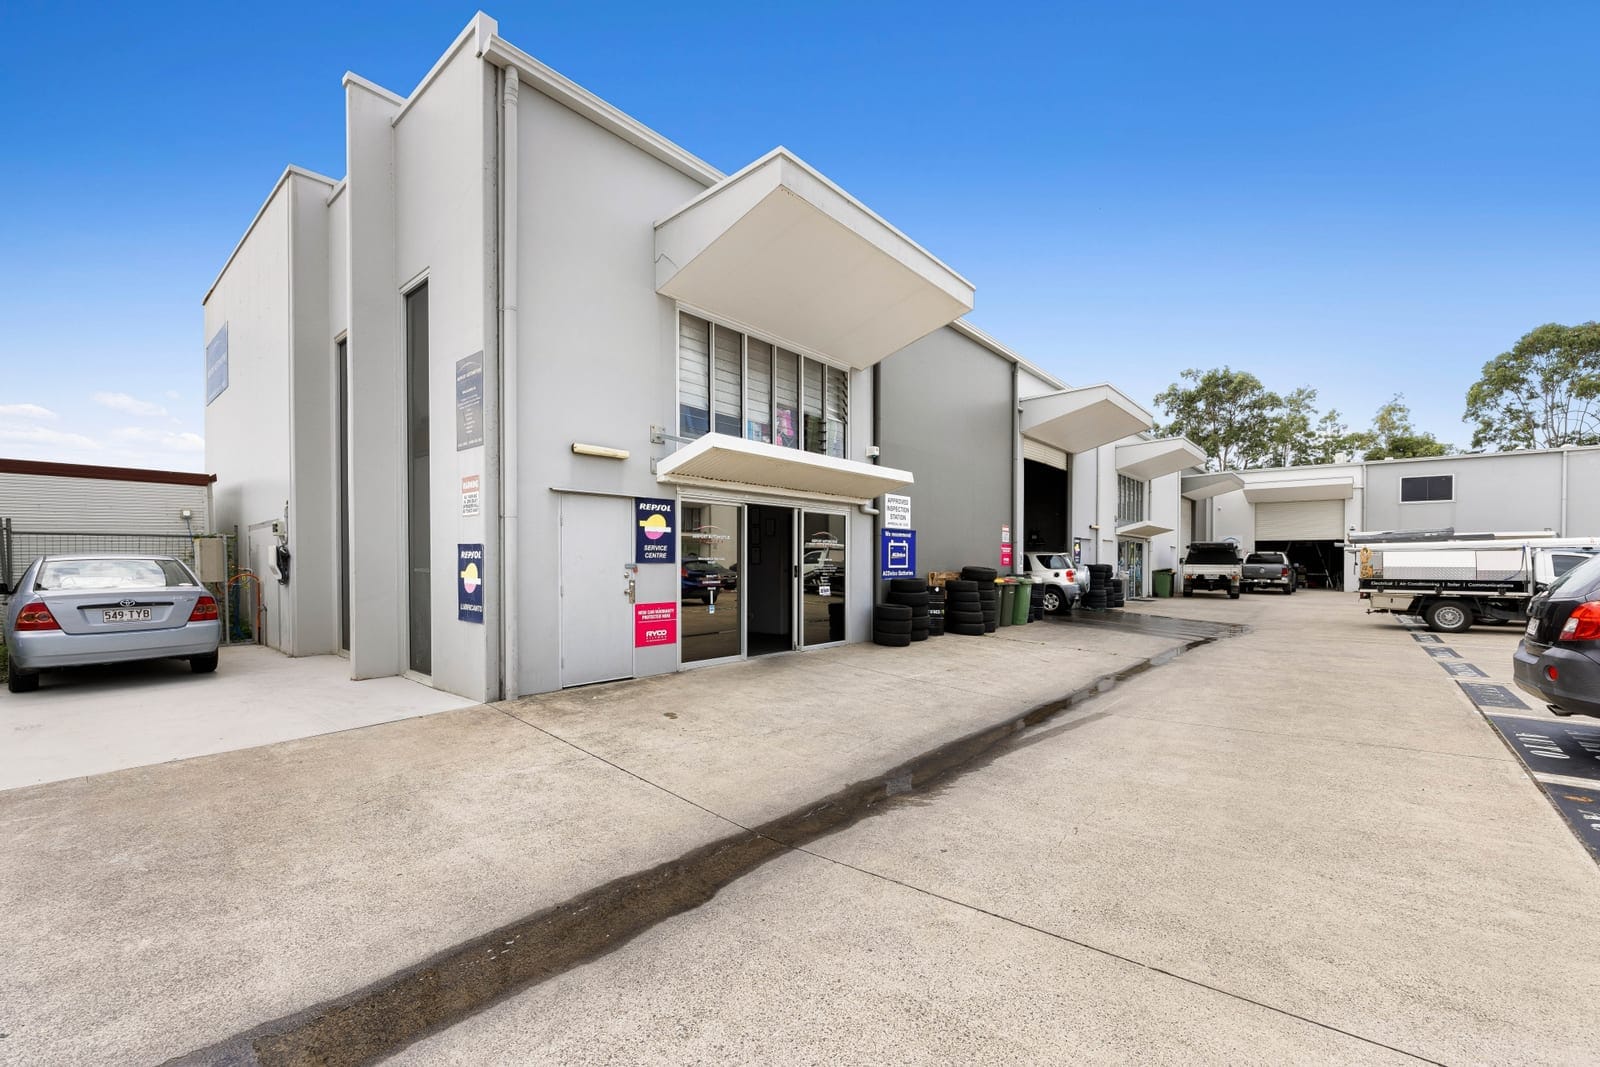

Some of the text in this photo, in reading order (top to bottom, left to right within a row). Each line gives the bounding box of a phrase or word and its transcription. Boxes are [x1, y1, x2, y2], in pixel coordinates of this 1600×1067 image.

[887, 497, 908, 506] APPROVED
[640, 503, 671, 512] REPSOL
[887, 505, 909, 513] INSPECTION
[890, 513, 907, 521] STATION
[460, 550, 481, 559] REPSOL
[646, 629, 668, 637] RYCO
